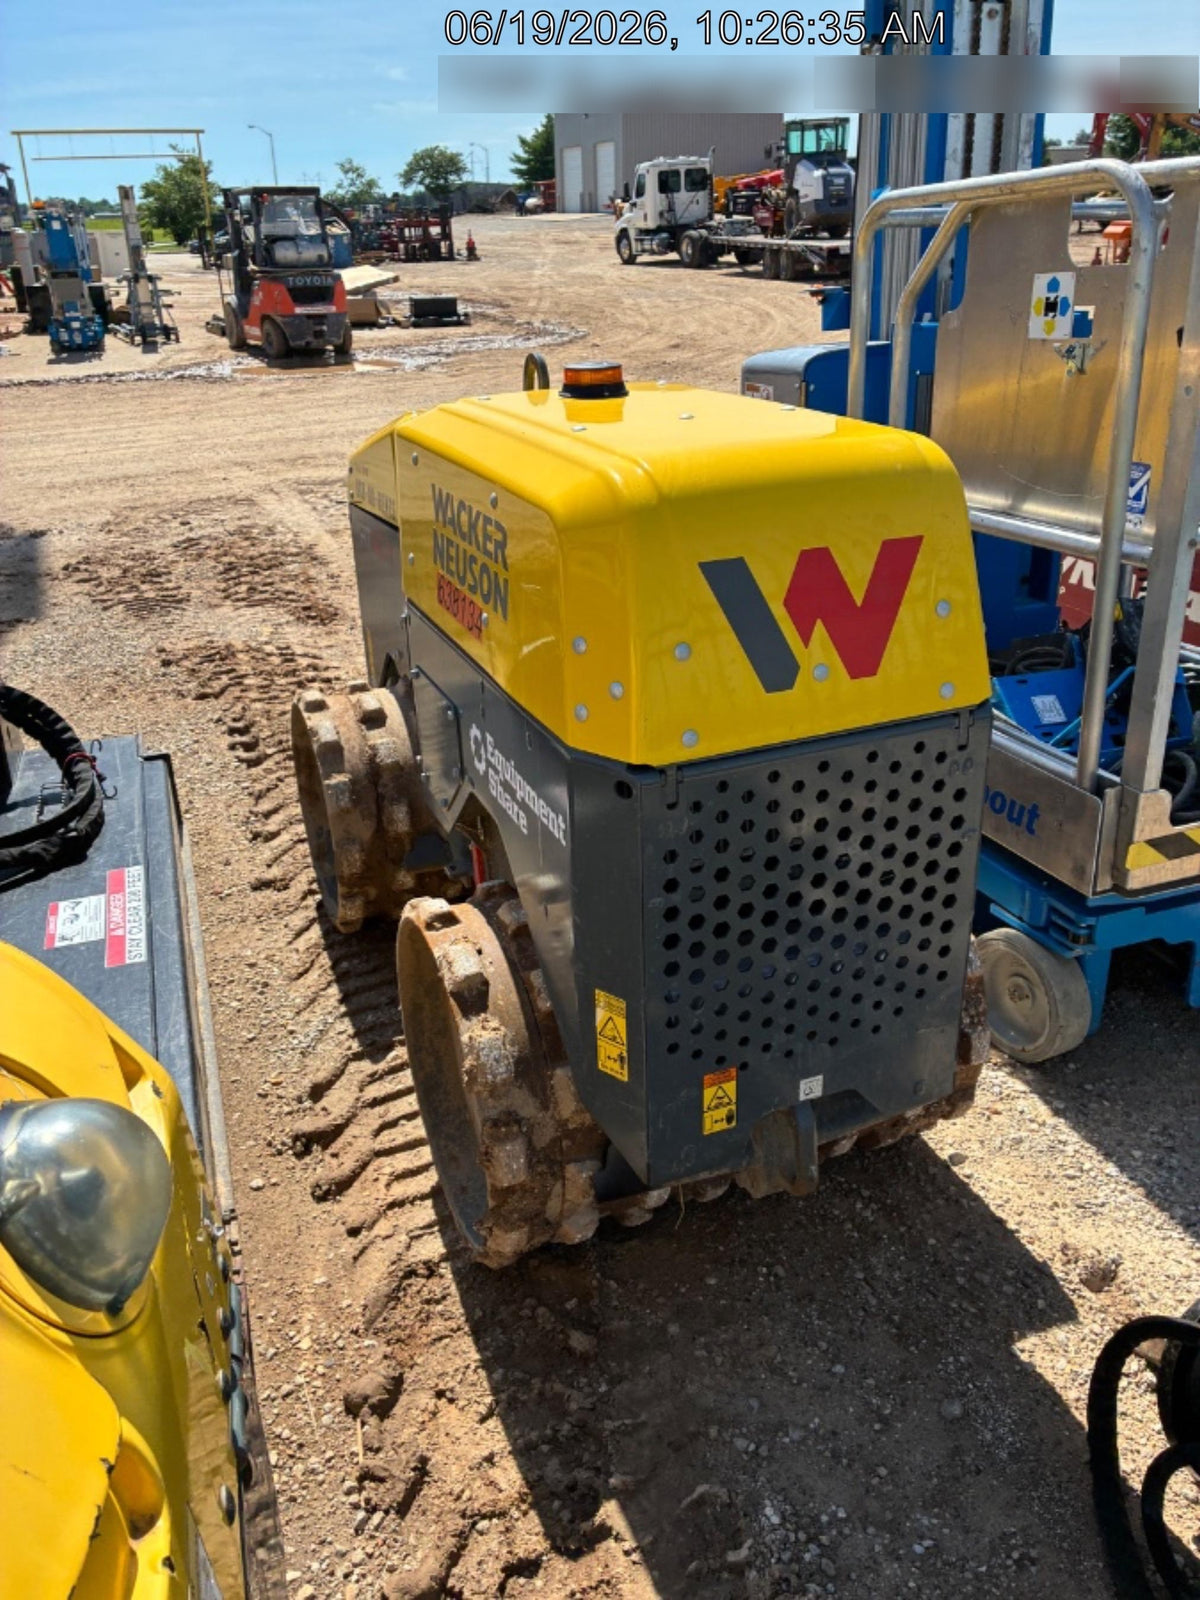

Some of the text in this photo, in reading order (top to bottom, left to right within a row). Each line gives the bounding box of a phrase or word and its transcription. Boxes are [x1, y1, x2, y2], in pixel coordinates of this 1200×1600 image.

[288, 276, 333, 287] TOYOTA
[432, 483, 508, 572] WACKER
[433, 528, 508, 621] NEUSON
[485, 731, 566, 847] Equipment
[488, 767, 528, 835] Share
[127, 907, 143, 936] CLEAR
